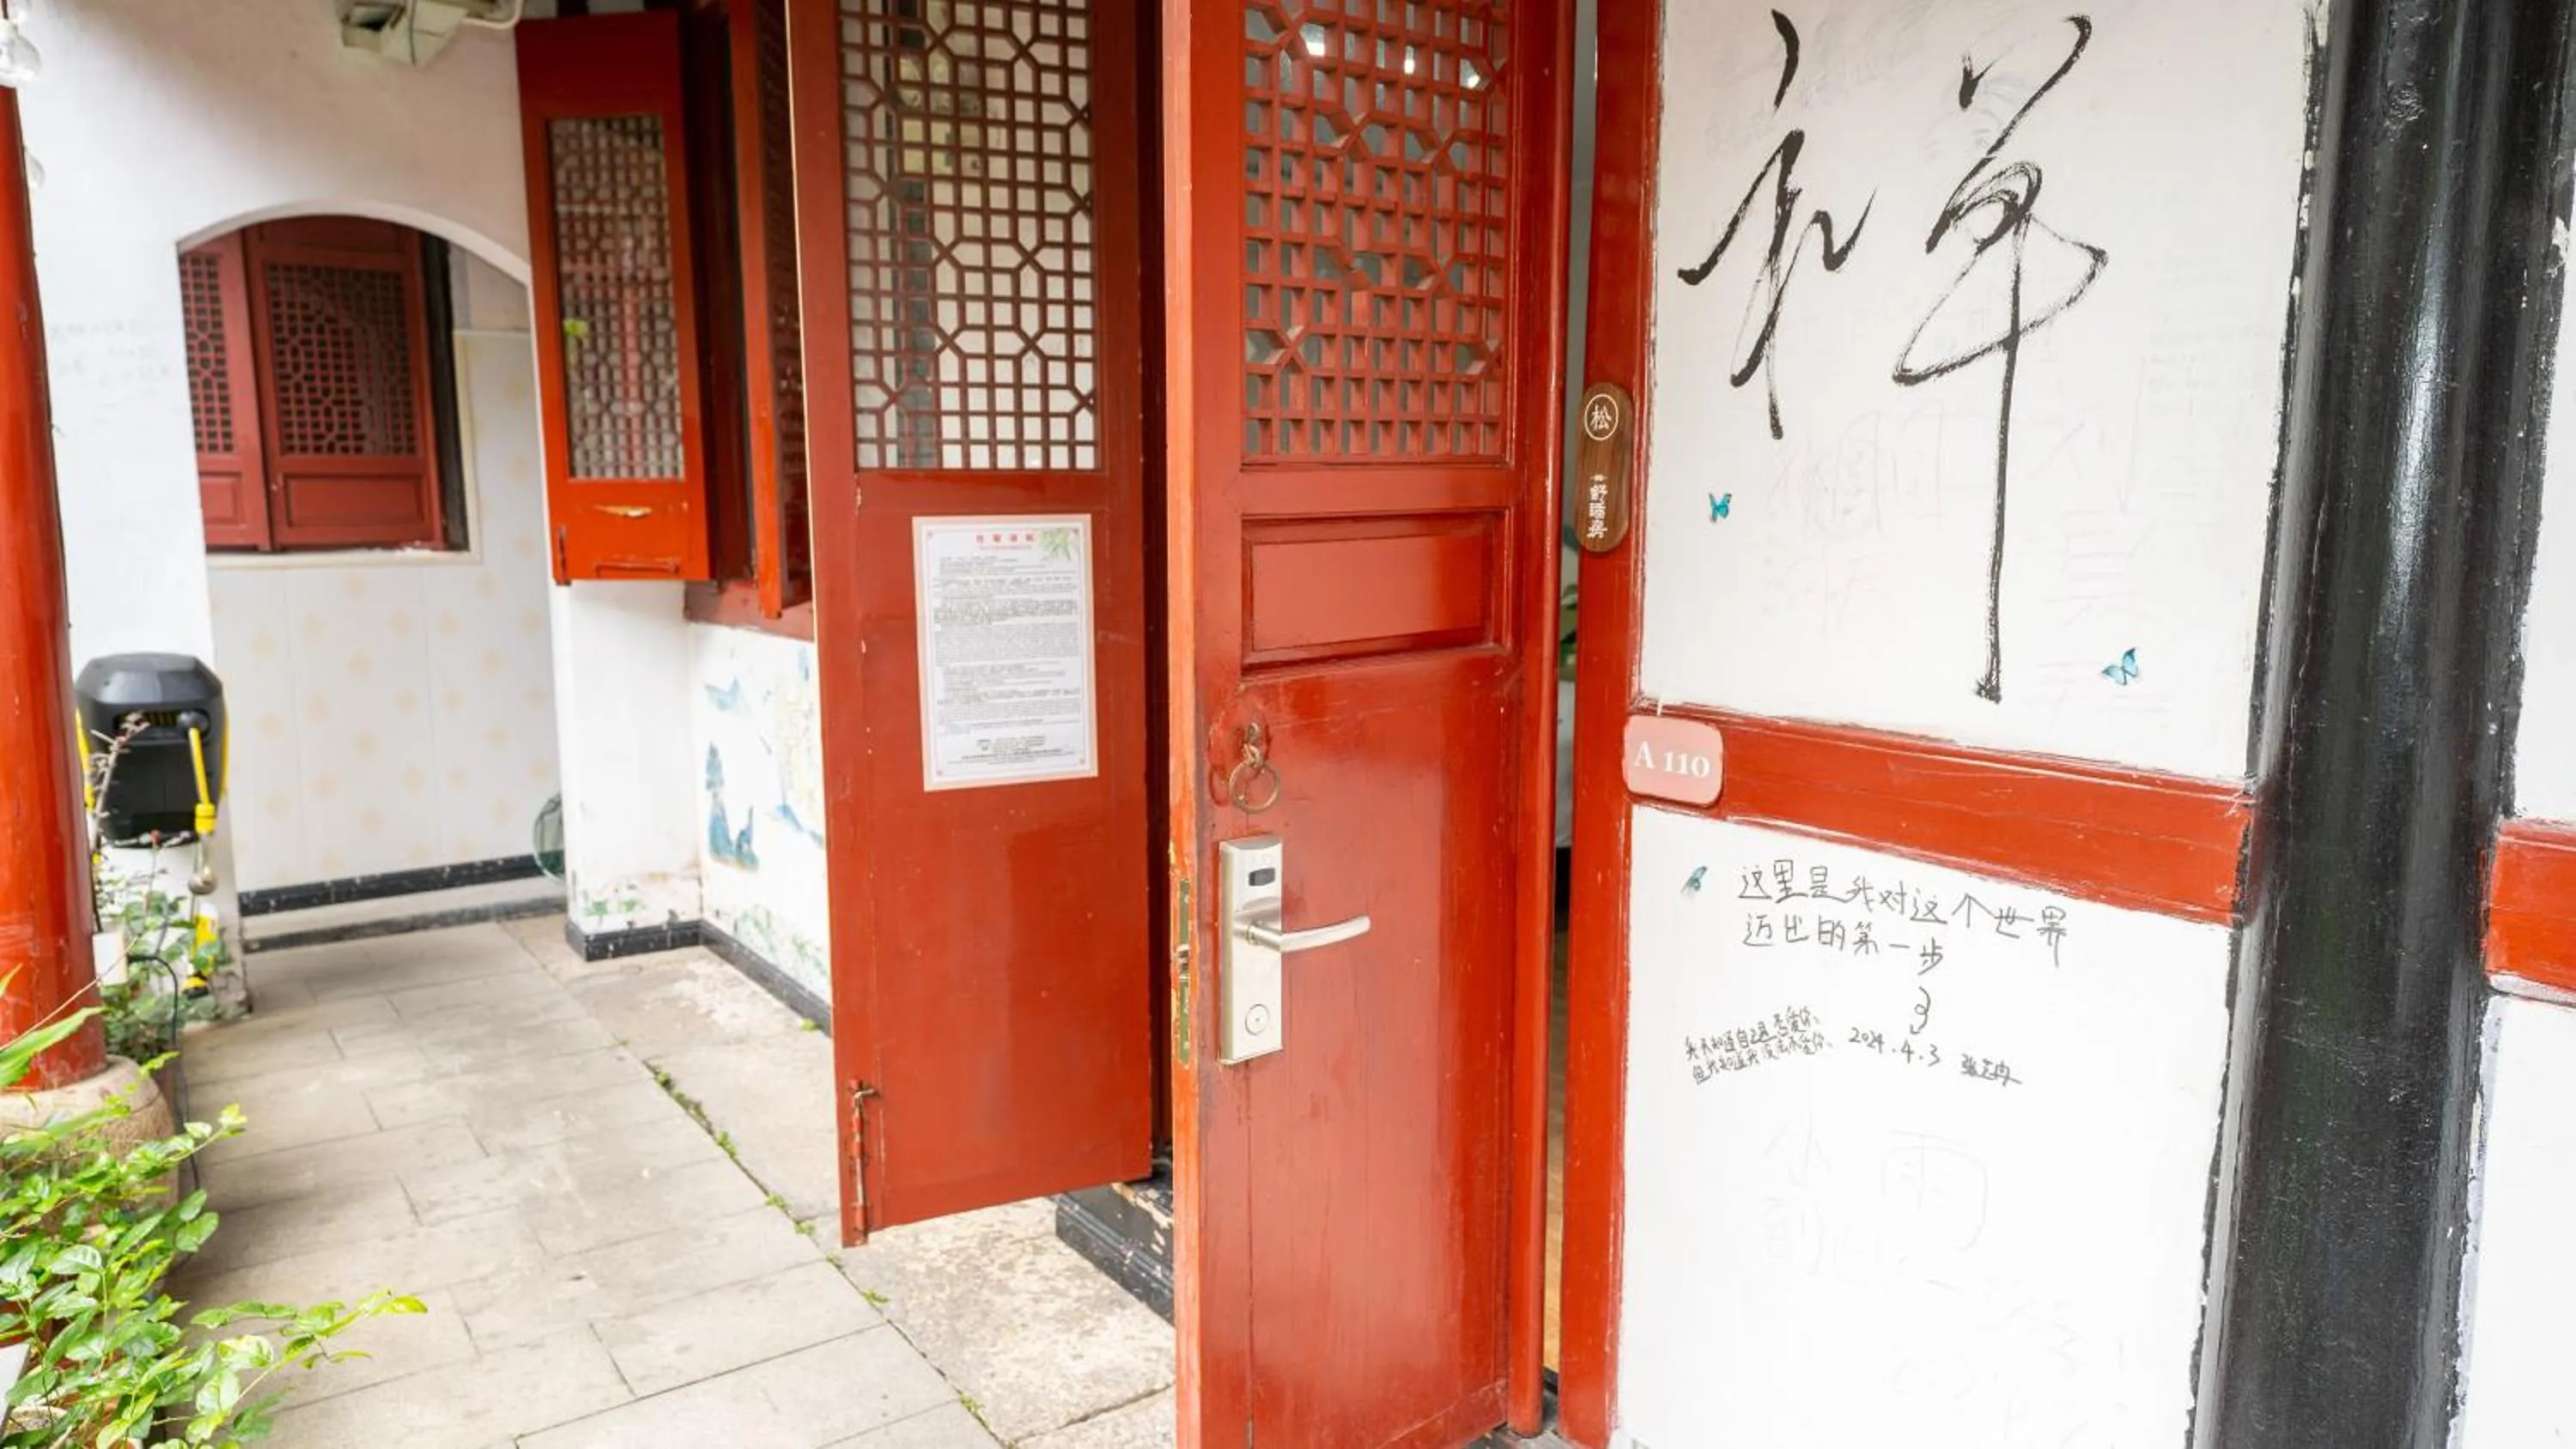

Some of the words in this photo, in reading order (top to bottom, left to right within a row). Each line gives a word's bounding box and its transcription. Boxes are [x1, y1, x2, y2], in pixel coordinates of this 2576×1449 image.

[1589, 403, 1613, 431] 松
[1634, 741, 1656, 770] A
[1662, 751, 1710, 779] 110
[1738, 859, 2068, 968] 这里是我对这个世界
[1741, 913, 1945, 976] 迈出的第一步
